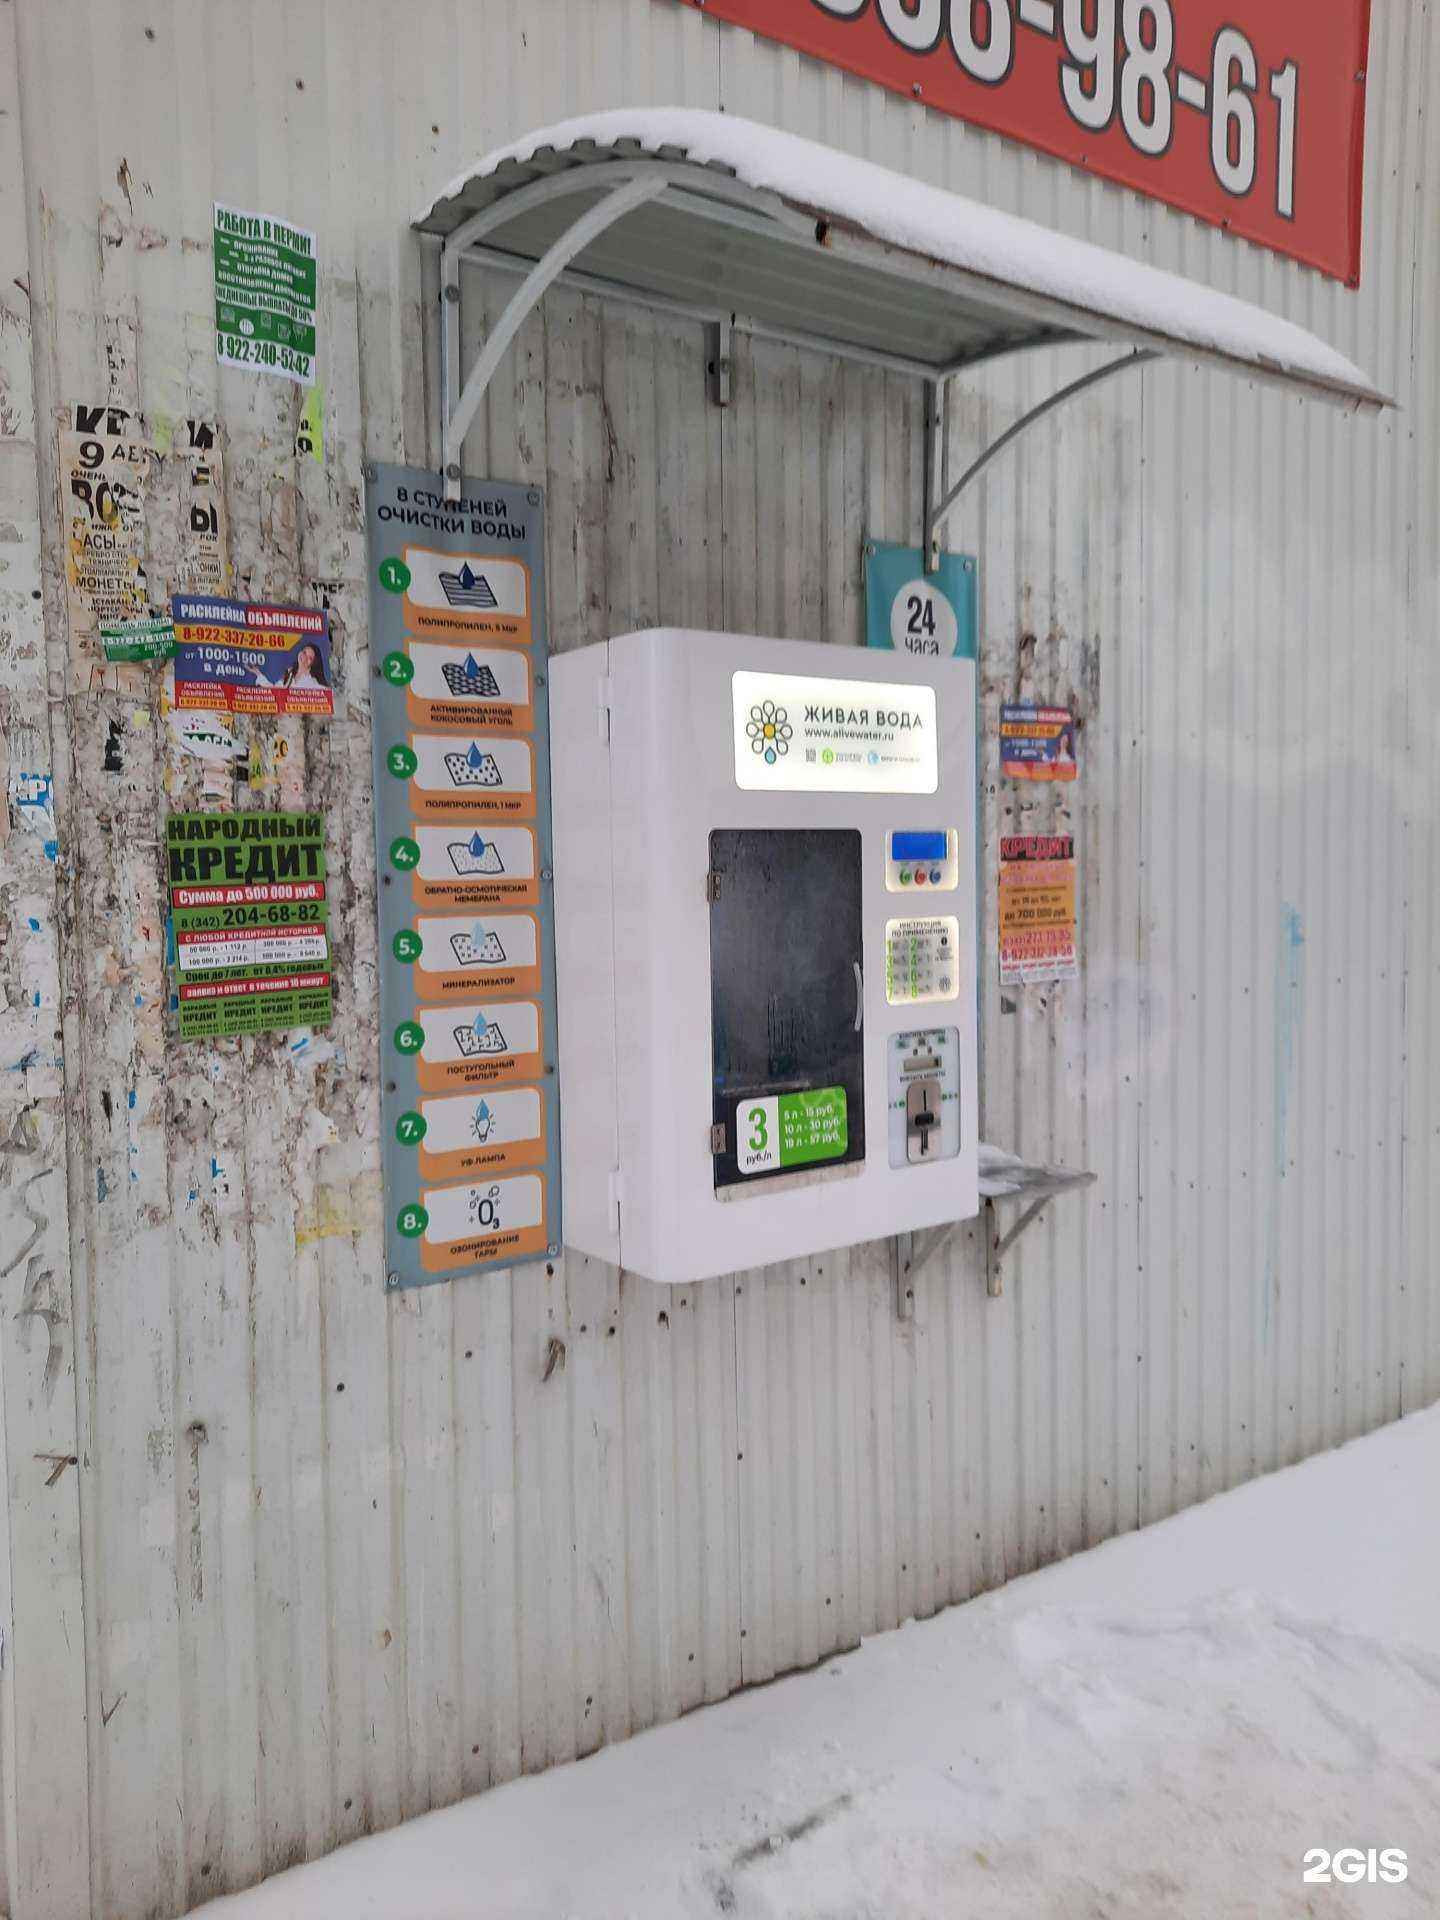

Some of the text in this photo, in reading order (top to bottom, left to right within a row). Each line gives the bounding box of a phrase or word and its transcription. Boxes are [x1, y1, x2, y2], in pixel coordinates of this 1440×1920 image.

[217, 208, 311, 256] РАБОТА В ПЕРМИ!
[217, 333, 224, 355] 8
[377, 505, 526, 541] ОЧИСТКИ ВОДЫ
[387, 565, 402, 585] 1.
[180, 603, 246, 624] РАСКЛЕЙКА
[247, 610, 322, 632] ОБЪЯВЛЕНИЙ
[907, 595, 937, 636] 24
[183, 627, 285, 648] 8-922-337-20-66
[215, 664, 246, 677] день
[390, 660, 407, 679] 2.
[430, 704, 513, 716] АКТИВИРОВАННЫЙ
[804, 704, 924, 731] ЖИВАЯ ВОДА
[804, 727, 895, 742] www.alivewater.ru
[393, 753, 411, 771] 3.
[168, 815, 320, 842] НАРОДНЫЙ
[395, 845, 414, 863] 4.
[1000, 836, 1071, 859] КРЕДИТ
[169, 844, 321, 884] КРЕДИТ
[179, 885, 319, 906] Сумма до 500 000 руб.
[454, 894, 501, 904] МЕМБРАНА
[191, 914, 220, 930] (342)
[223, 904, 320, 926] 204-68-82
[399, 938, 415, 956] 5.
[442, 977, 516, 990] МИНЕРАЛИЗАТОР
[224, 1008, 256, 1018] КРЕДИТ
[261, 1005, 293, 1014] КРЕДИТ
[298, 999, 329, 1010] КРЕДИТ
[183, 1011, 217, 1022] КРЕДИТ
[400, 1030, 418, 1048] 6.
[446, 1059, 516, 1075] ПОСТУГОЛЬНЫЙ
[402, 1121, 419, 1138] 7.
[748, 1108, 768, 1151] 3
[785, 1124, 794, 1134] 10
[475, 1152, 506, 1166] ЛАМПА
[403, 1212, 423, 1230] 8.
[450, 1234, 520, 1255] ОЗОНИРОВАНИЕ
